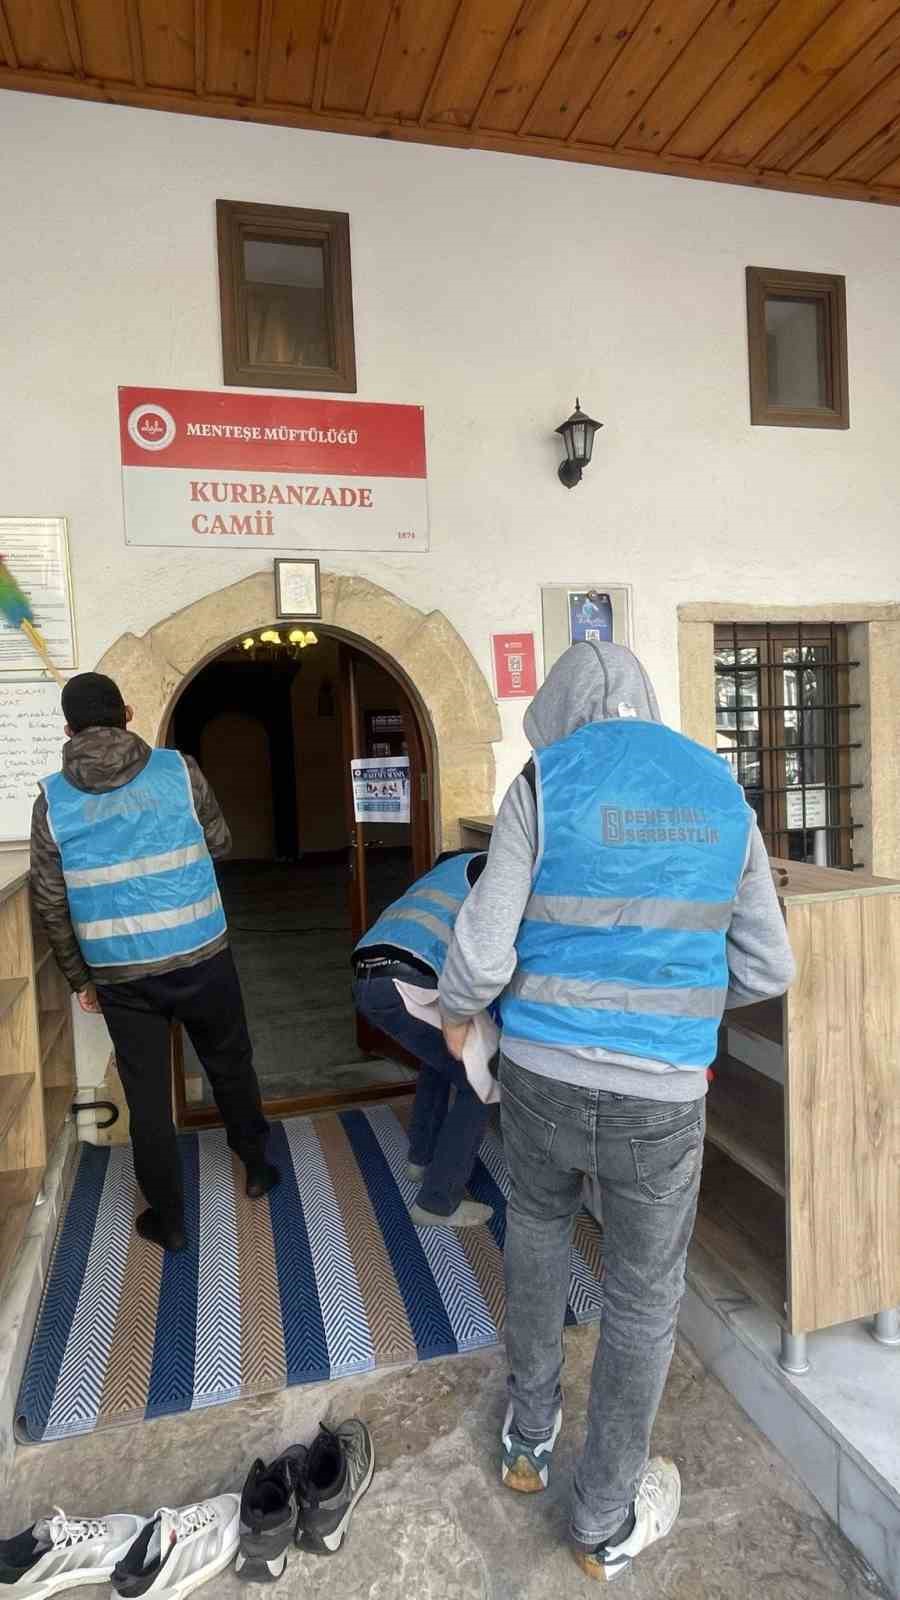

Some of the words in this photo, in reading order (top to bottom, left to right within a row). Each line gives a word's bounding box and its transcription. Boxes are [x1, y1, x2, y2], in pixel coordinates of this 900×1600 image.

[186, 423, 261, 441] MENTEŞE
[264, 427, 359, 445] MÜFTÜLÜĞÜ
[189, 481, 374, 508] KURBANZADE
[191, 510, 275, 536] CAMİİ
